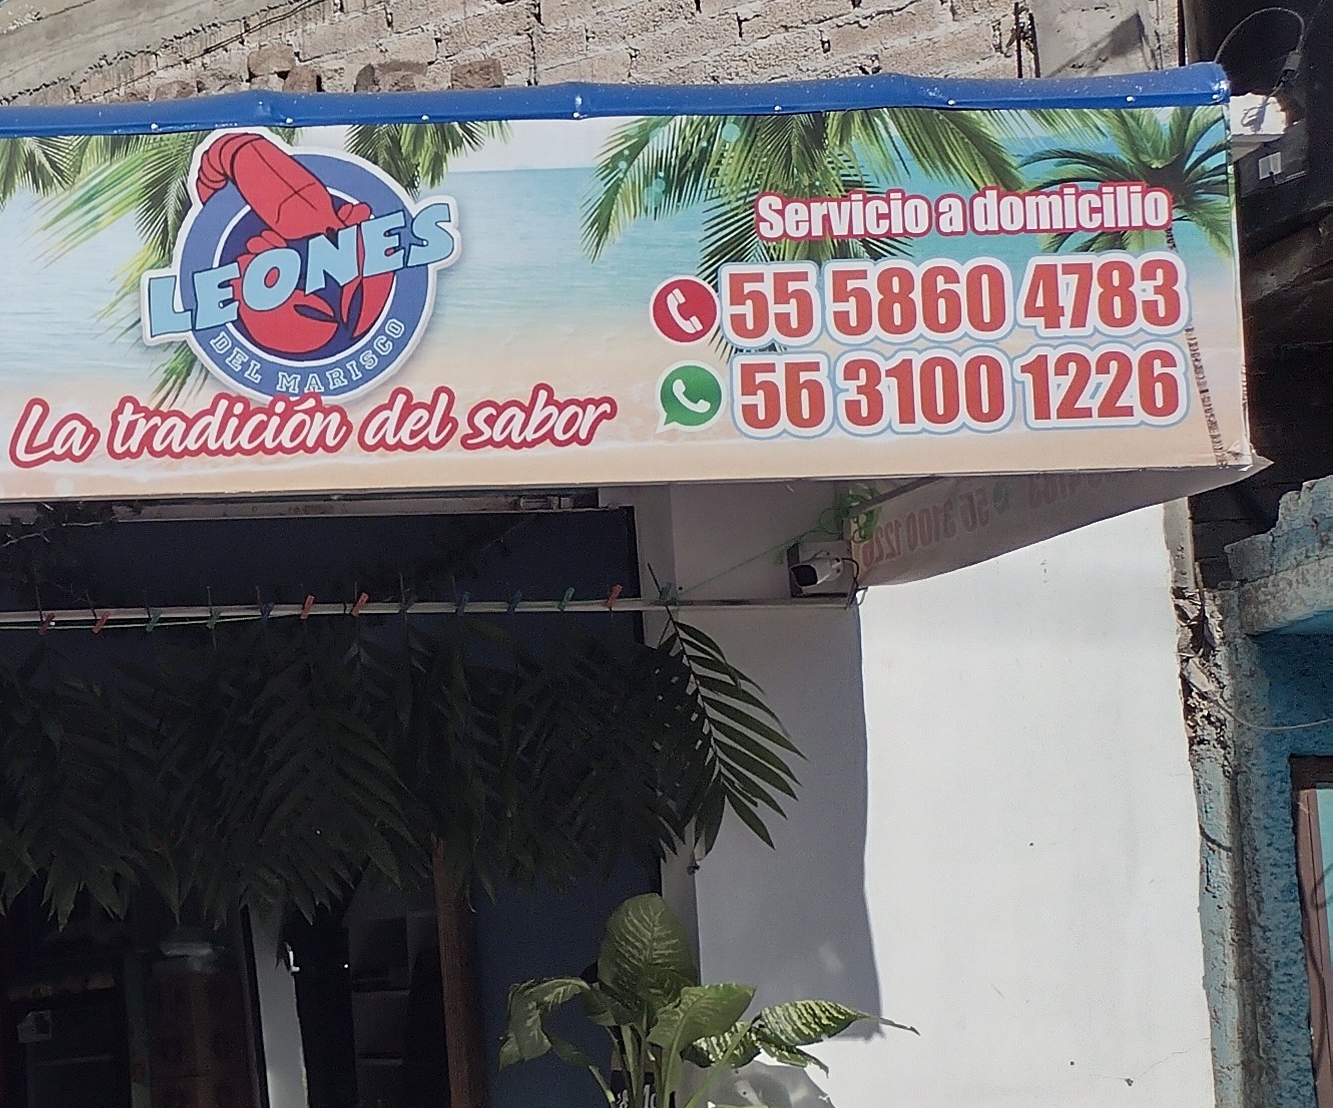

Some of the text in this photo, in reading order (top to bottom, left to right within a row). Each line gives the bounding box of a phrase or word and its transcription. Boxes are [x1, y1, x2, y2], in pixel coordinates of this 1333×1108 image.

[757, 185, 1171, 238] Servicio a domicilio
[148, 202, 455, 338] LEONES
[728, 258, 1180, 338] 55 5860 4783
[210, 317, 405, 394] DEL MARISCO
[841, 353, 1007, 427] 3100
[1019, 347, 1181, 422] 1226
[13, 386, 616, 464] La tradición del sabor
